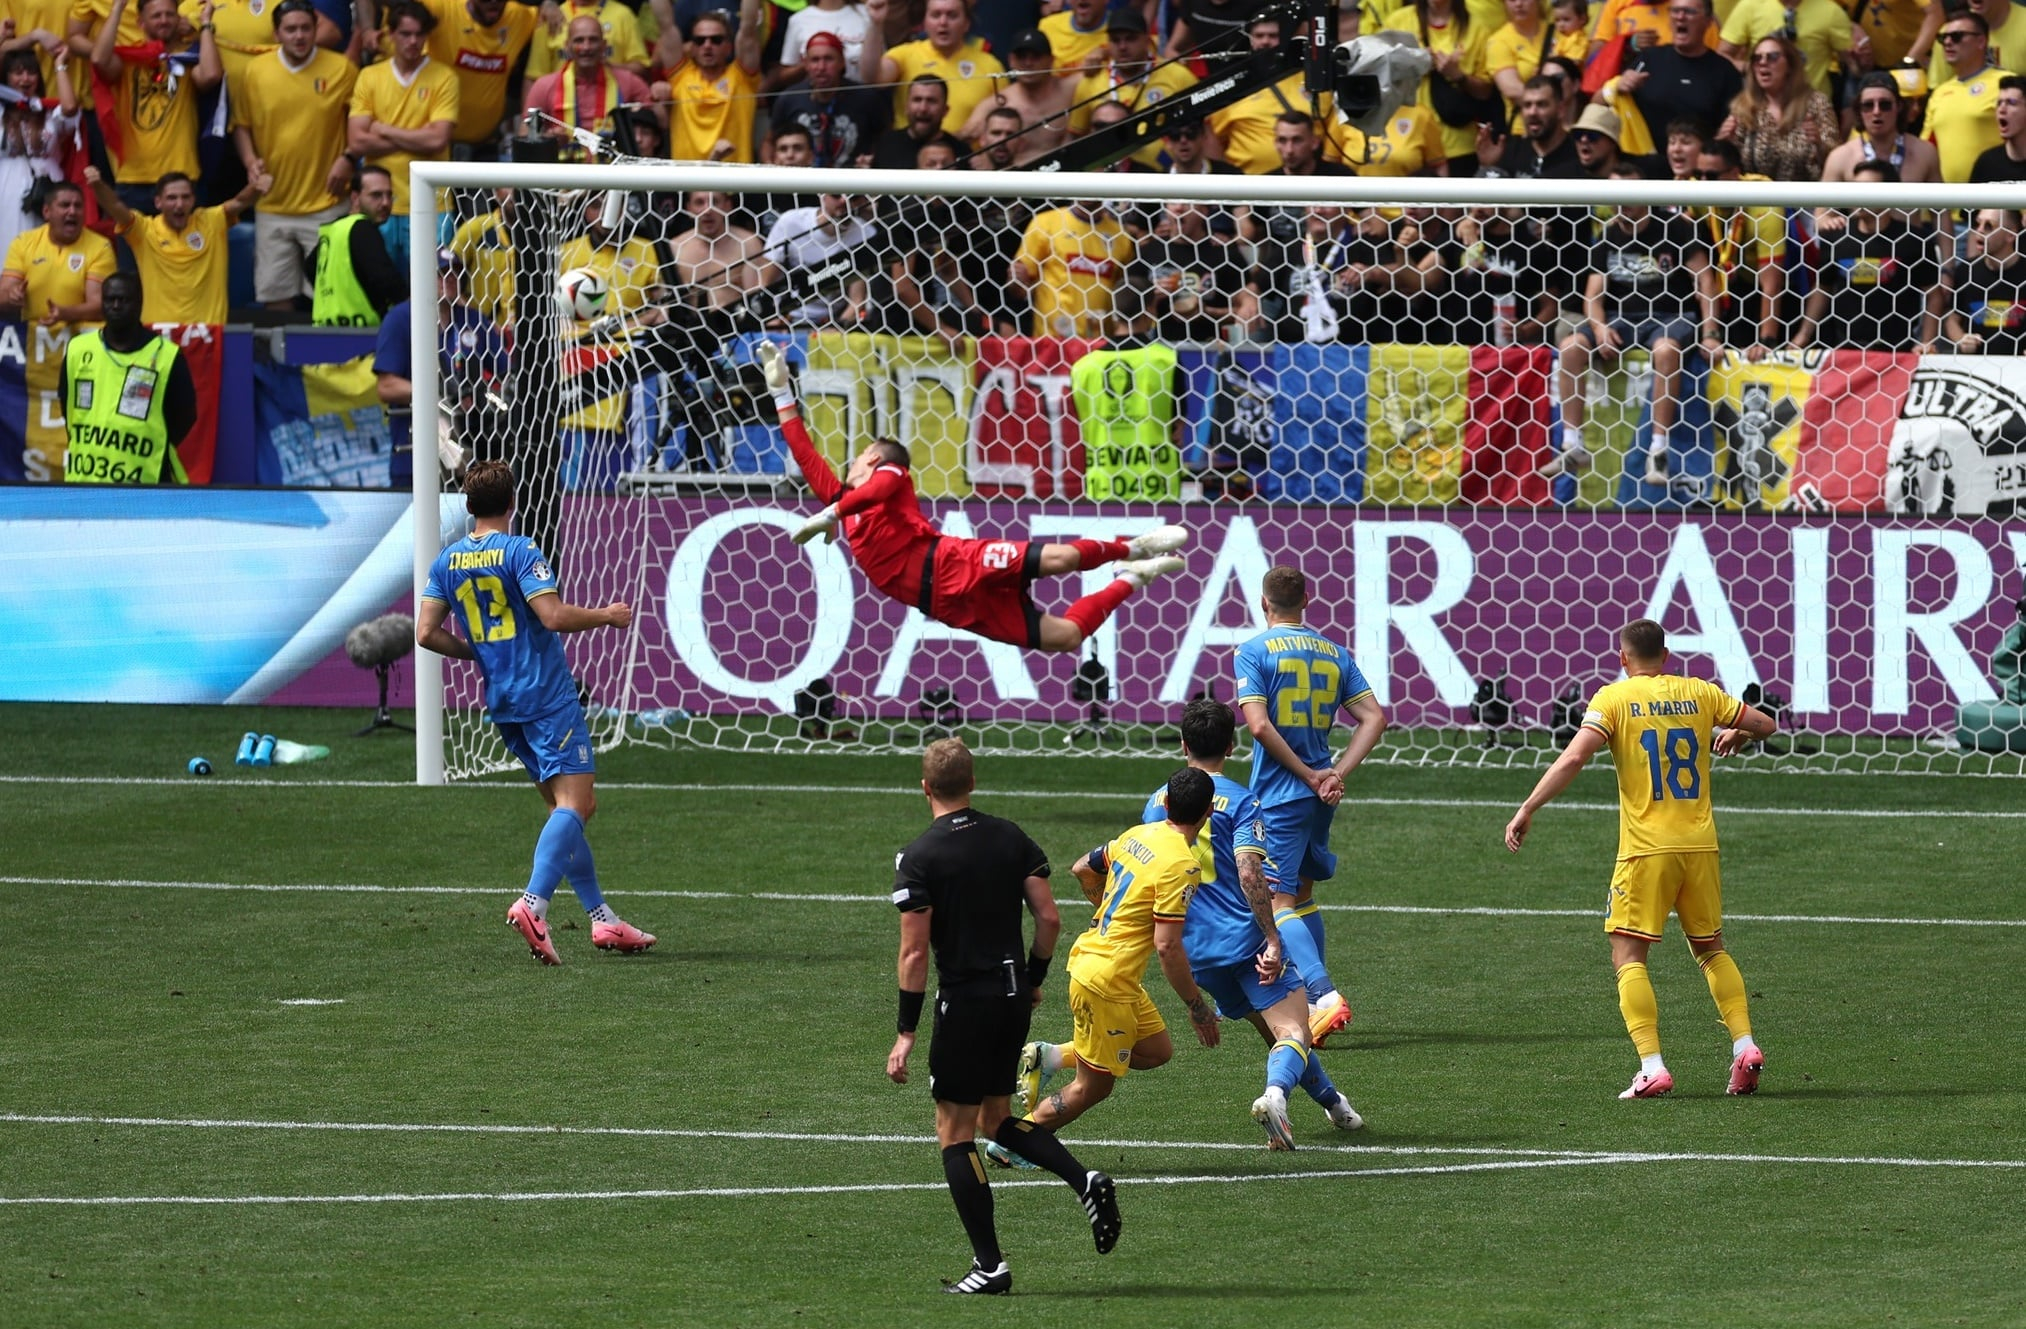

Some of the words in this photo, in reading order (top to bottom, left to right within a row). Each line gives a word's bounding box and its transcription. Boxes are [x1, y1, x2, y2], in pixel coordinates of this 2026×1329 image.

[1904, 380, 2015, 445] ULTRA
[455, 575, 517, 643] 13
[665, 506, 1482, 714] QATAR
[1616, 522, 2026, 715] AIR
[1276, 657, 1341, 730] 22
[1630, 702, 1646, 718] R.
[1650, 700, 1699, 718] MARIN
[1639, 727, 1700, 801] 18
